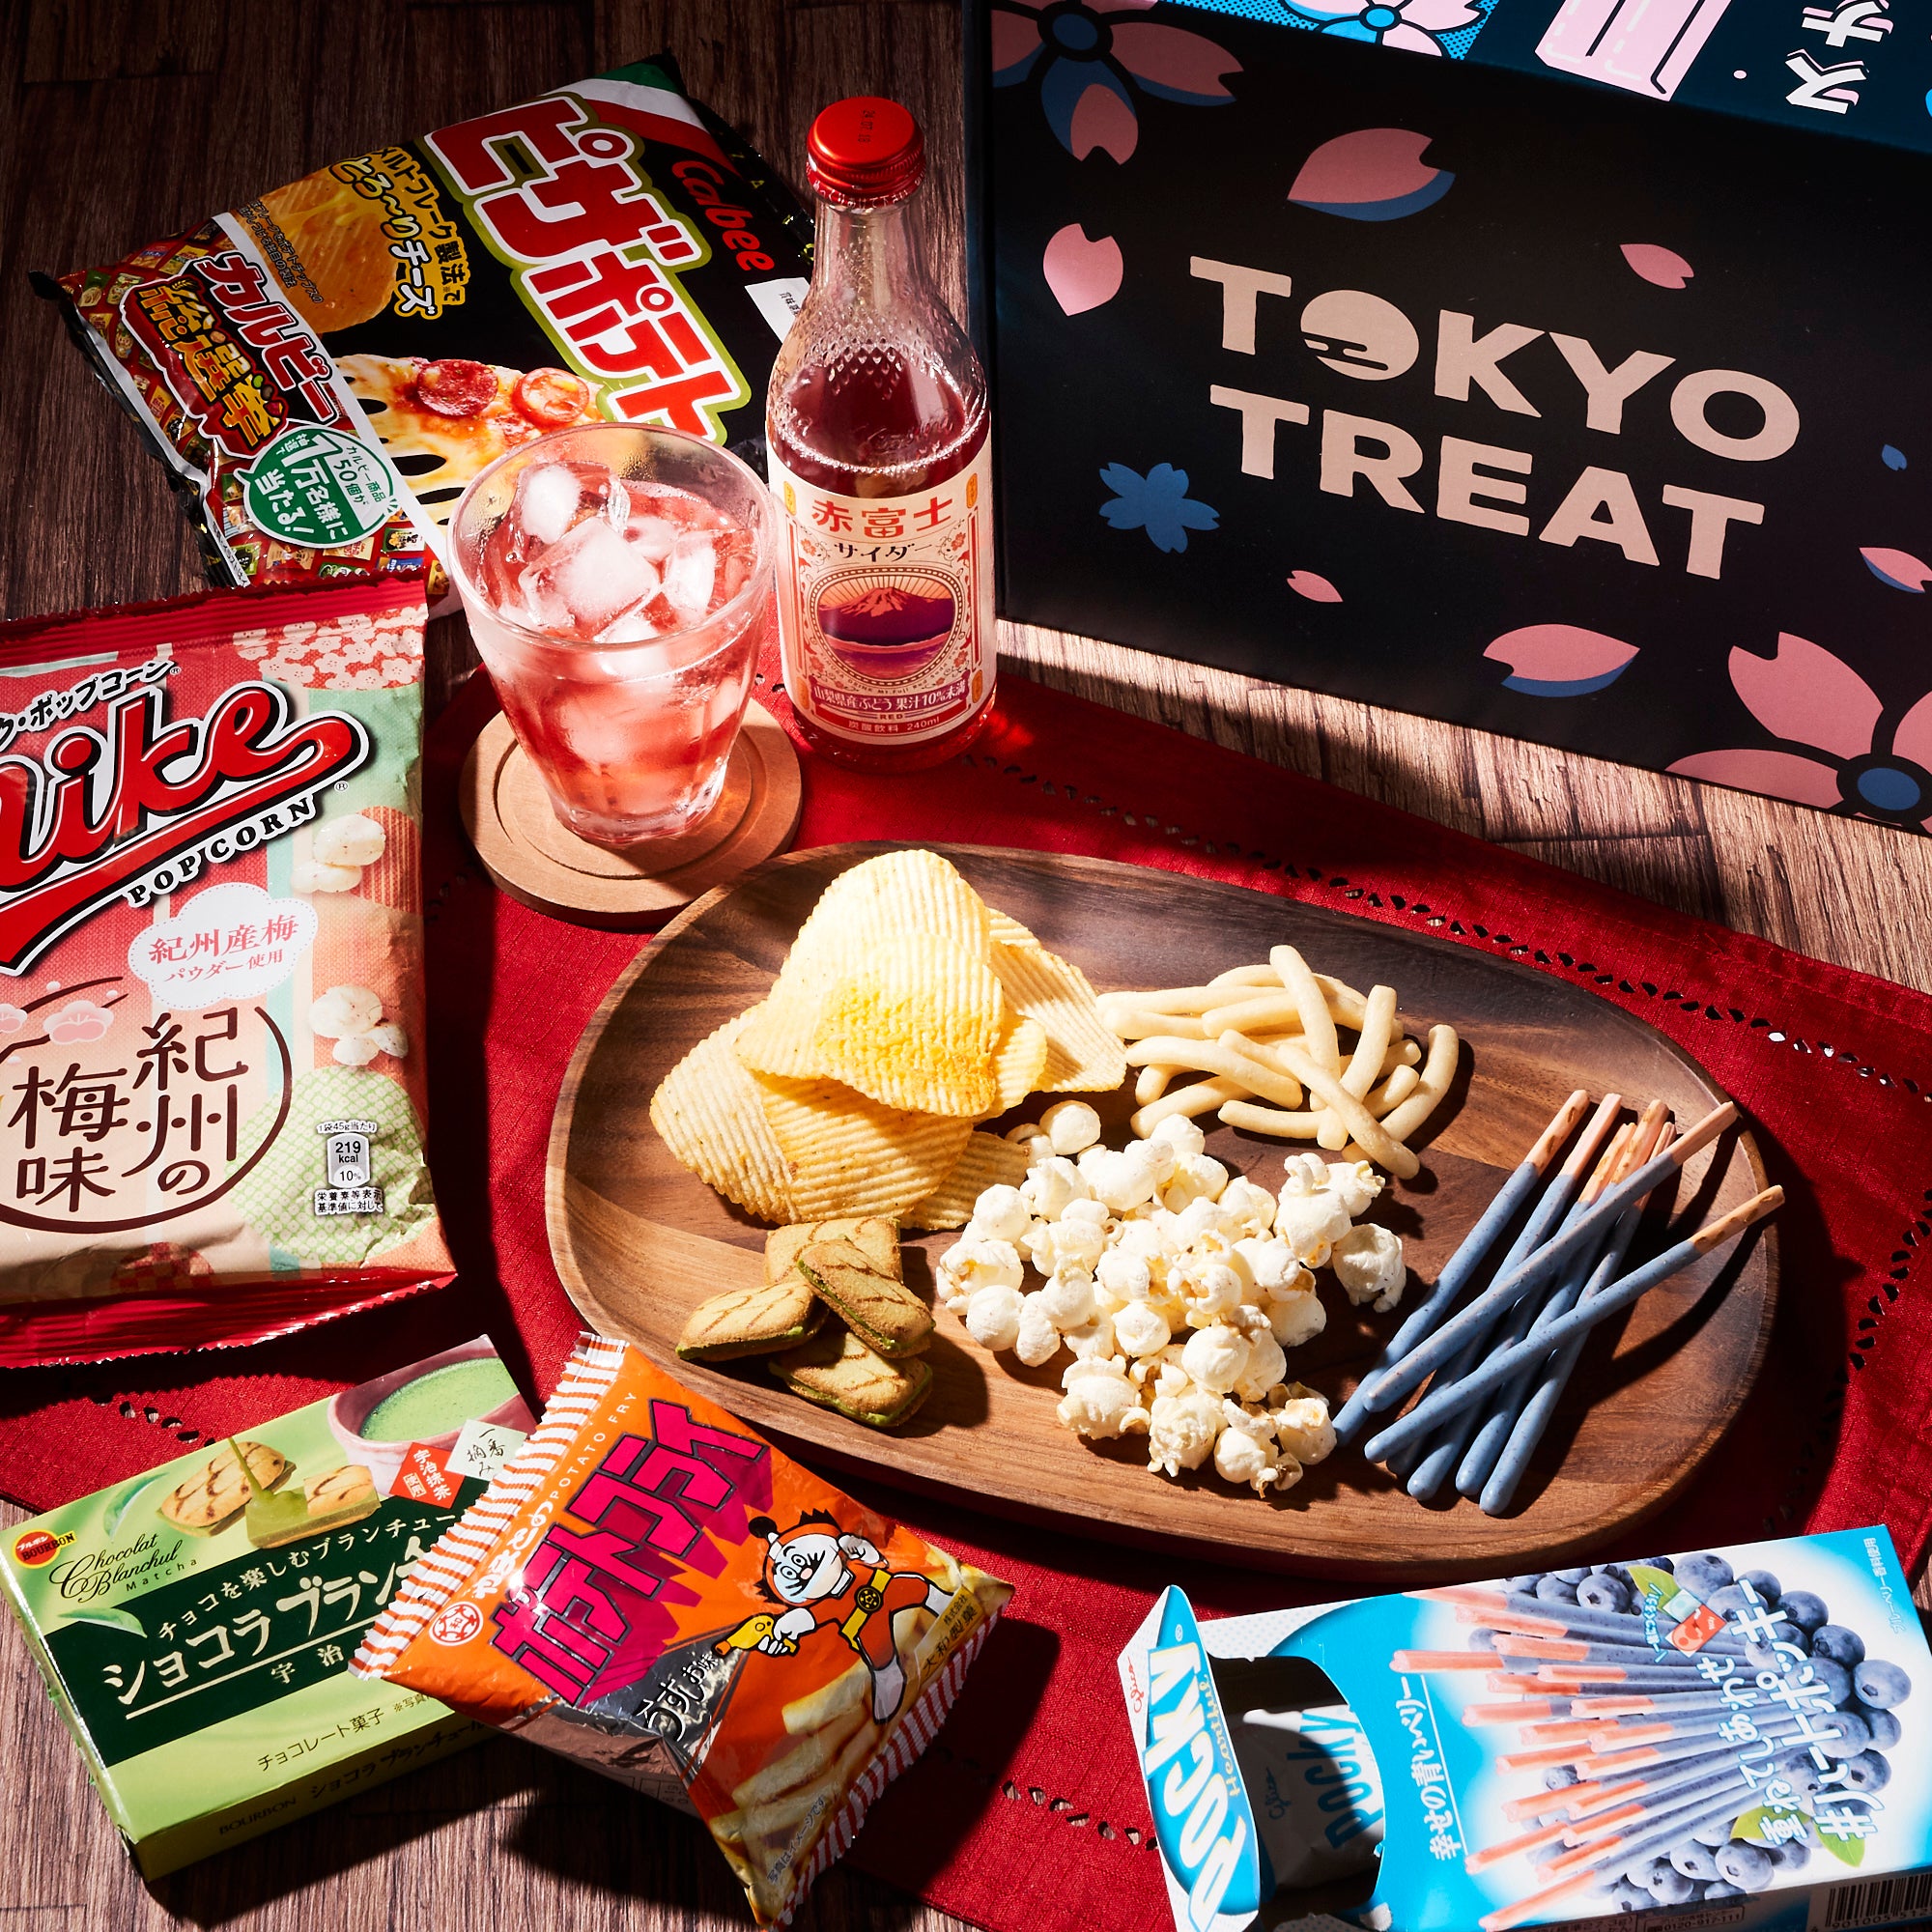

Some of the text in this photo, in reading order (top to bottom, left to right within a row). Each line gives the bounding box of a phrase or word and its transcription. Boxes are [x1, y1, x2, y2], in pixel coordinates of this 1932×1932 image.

[672, 159, 775, 271] Calbee
[431, 98, 735, 438] ピザポテト
[138, 285, 280, 446] 総選挙
[197, 256, 332, 420] カルビー
[1190, 256, 1800, 461] TOKYO
[281, 432, 349, 540] 1万名様に
[333, 459, 370, 506] 50個が
[346, 446, 386, 502] カルビー商品
[1209, 384, 1764, 580] TREAT
[812, 497, 952, 538] 赤富士
[834, 543, 932, 562] サイダー
[848, 716, 940, 732] 炭酸飲料 240ml
[129, 797, 311, 904] POPCORN
[149, 914, 299, 965] 紀州産梅
[163, 949, 284, 983] パウダー使用
[122, 1007, 249, 1195] 紀州の
[8, 1063, 130, 1213] 梅味
[335, 1141, 361, 1153] 219
[338, 1154, 358, 1163] kcal
[317, 1189, 382, 1201] 栄養素等表示
[318, 1201, 383, 1213] 基準値に対して
[340, 1171, 361, 1181] 10%
[413, 1449, 452, 1500] 宇治抹茶
[550, 1392, 637, 1500] POTATO FRY
[16, 1535, 49, 1551] ブルボン
[21, 1532, 75, 1562] BOURBON
[49, 1532, 159, 1599] Chocolat
[70, 1539, 184, 1603] Blanchul
[490, 1399, 771, 1706] ポテトフライ
[127, 1559, 197, 1592] Matcha
[636, 1653, 719, 1742] うすしお味
[257, 1708, 384, 1772] チョコレート菓子
[1396, 1676, 1462, 1860] 幸せの青いベリー
[1697, 1656, 1809, 1844] 重ねてしあわせ
[219, 1797, 297, 1834] BOURBON
